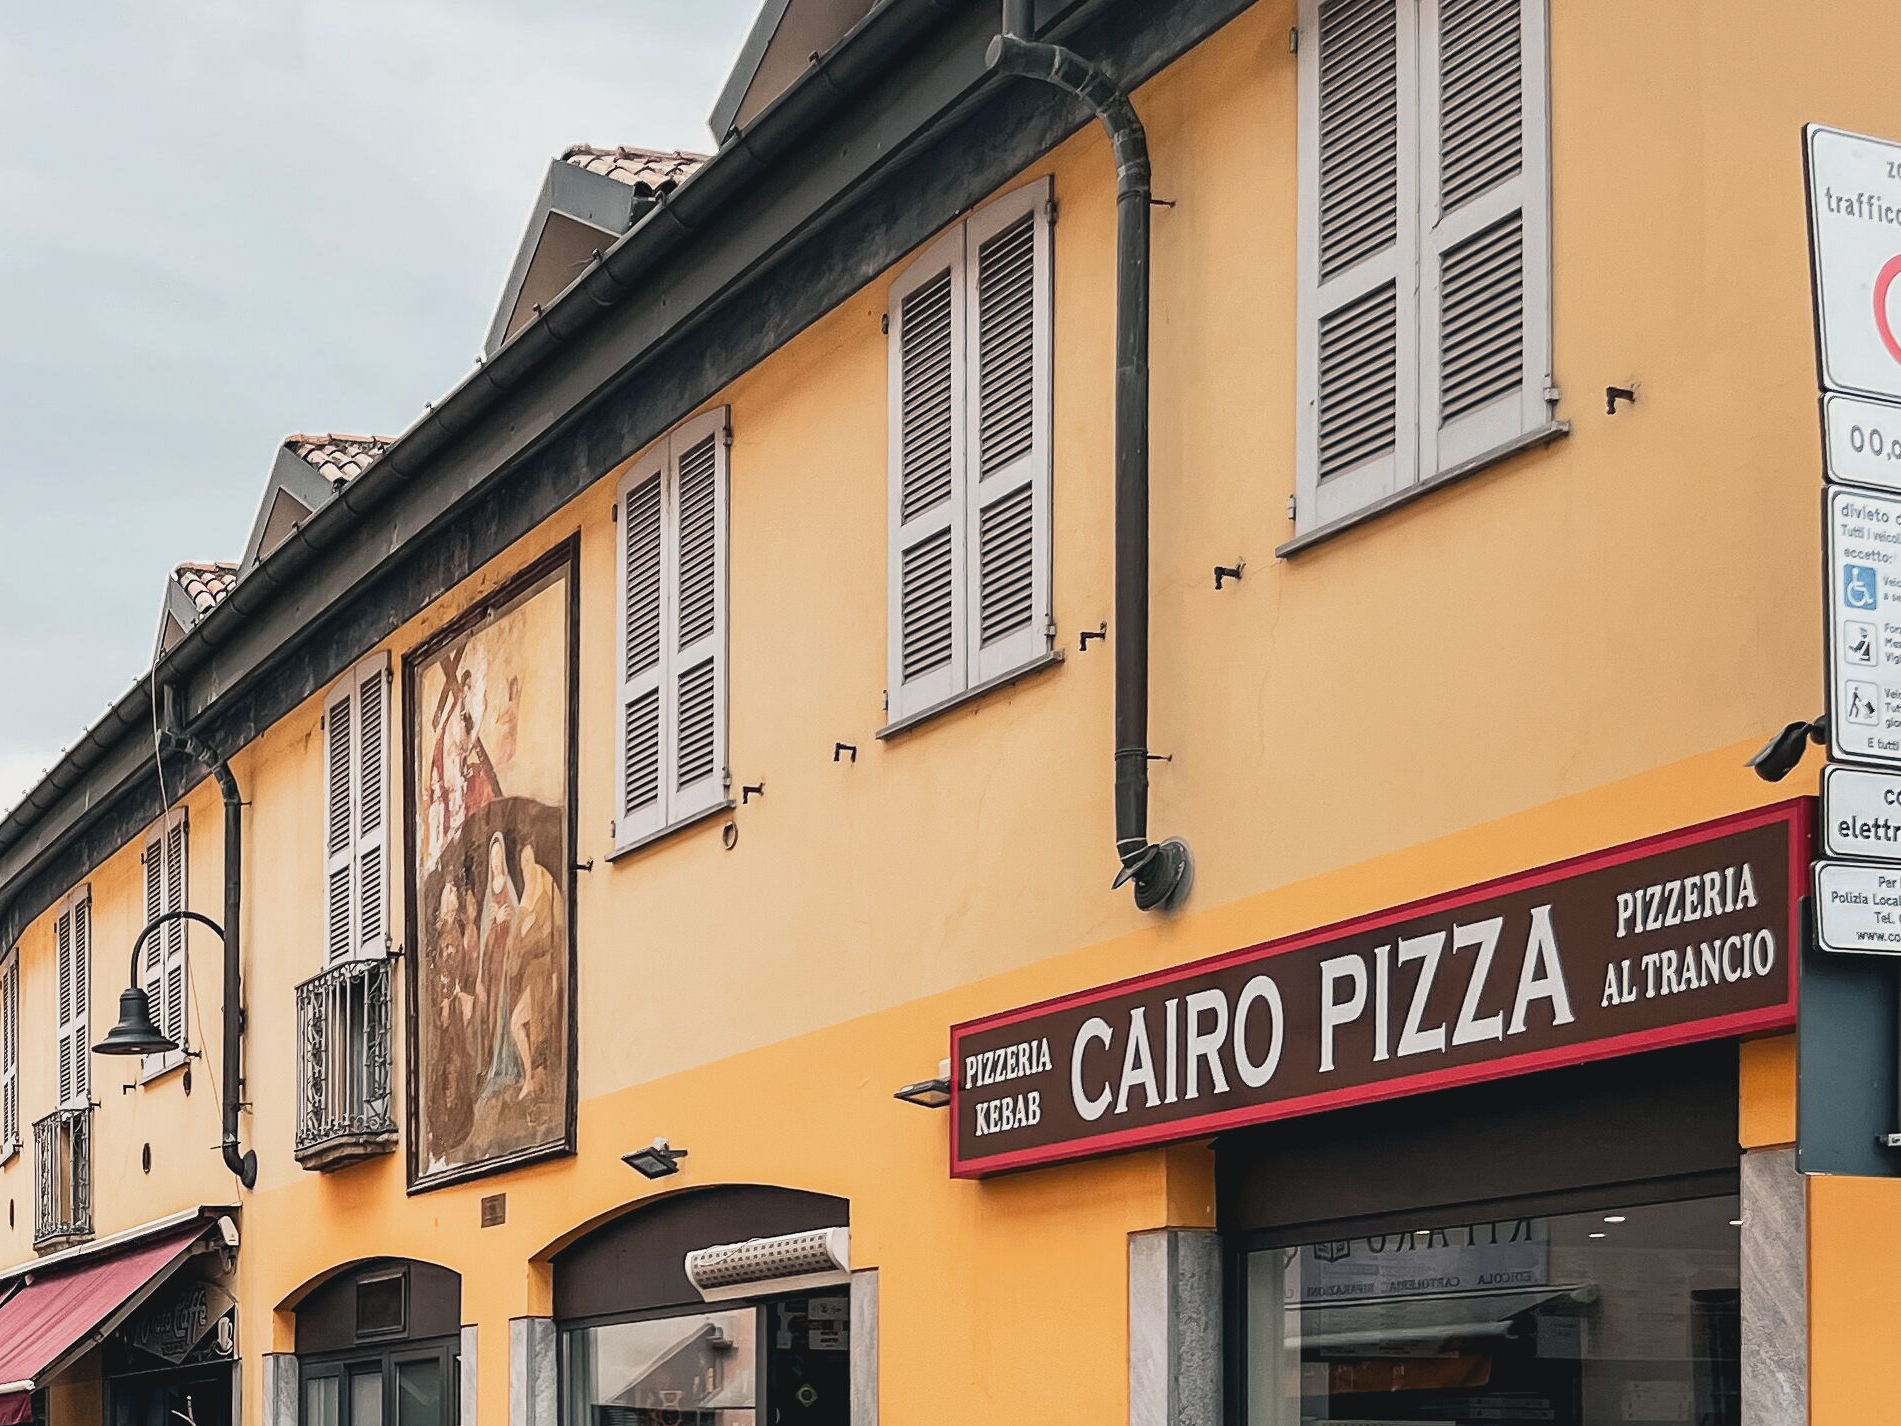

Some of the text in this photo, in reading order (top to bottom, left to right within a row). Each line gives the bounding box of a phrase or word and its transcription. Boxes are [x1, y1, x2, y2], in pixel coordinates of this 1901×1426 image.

[1841, 503, 1889, 523] divieto
[1615, 861, 1759, 939] PIZZERIA
[1831, 891, 1869, 905] Polizia
[1878, 876, 1897, 889] Per
[1601, 928, 1777, 1009] AL TRANCIO
[1070, 903, 1577, 1122] CAIRO PIZZA
[964, 1036, 1053, 1090] PIZZERIA
[974, 1090, 1042, 1138] KEBAB
